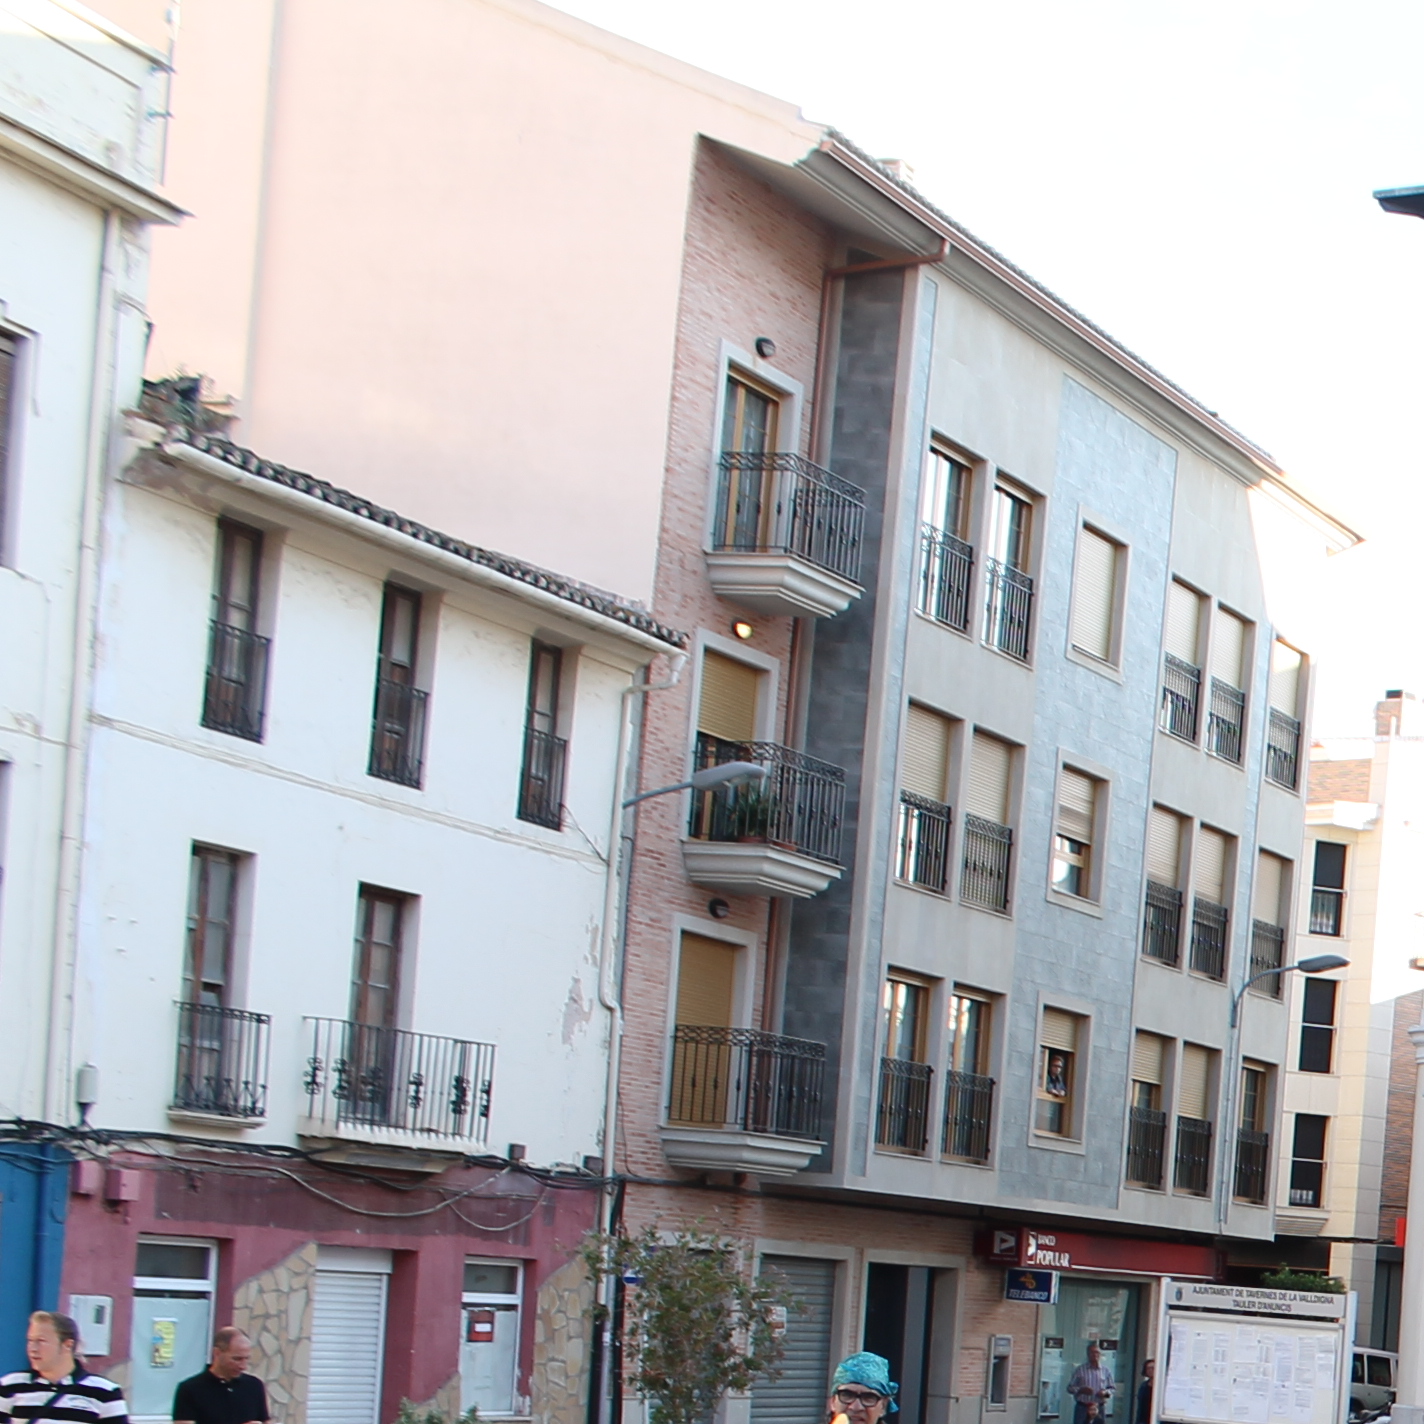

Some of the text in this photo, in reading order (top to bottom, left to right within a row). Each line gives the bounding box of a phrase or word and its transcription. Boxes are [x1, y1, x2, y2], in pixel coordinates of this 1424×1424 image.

[1037, 1233, 1056, 1246] BANCO
[1036, 1249, 1070, 1267] POPULAR
[1009, 1289, 1049, 1300] TELEBANCO
[1192, 1286, 1335, 1305] AJUNTAMENT DE TAVERNES DE LA VALLDIGNA
[1232, 1299, 1256, 1309] TAULER
